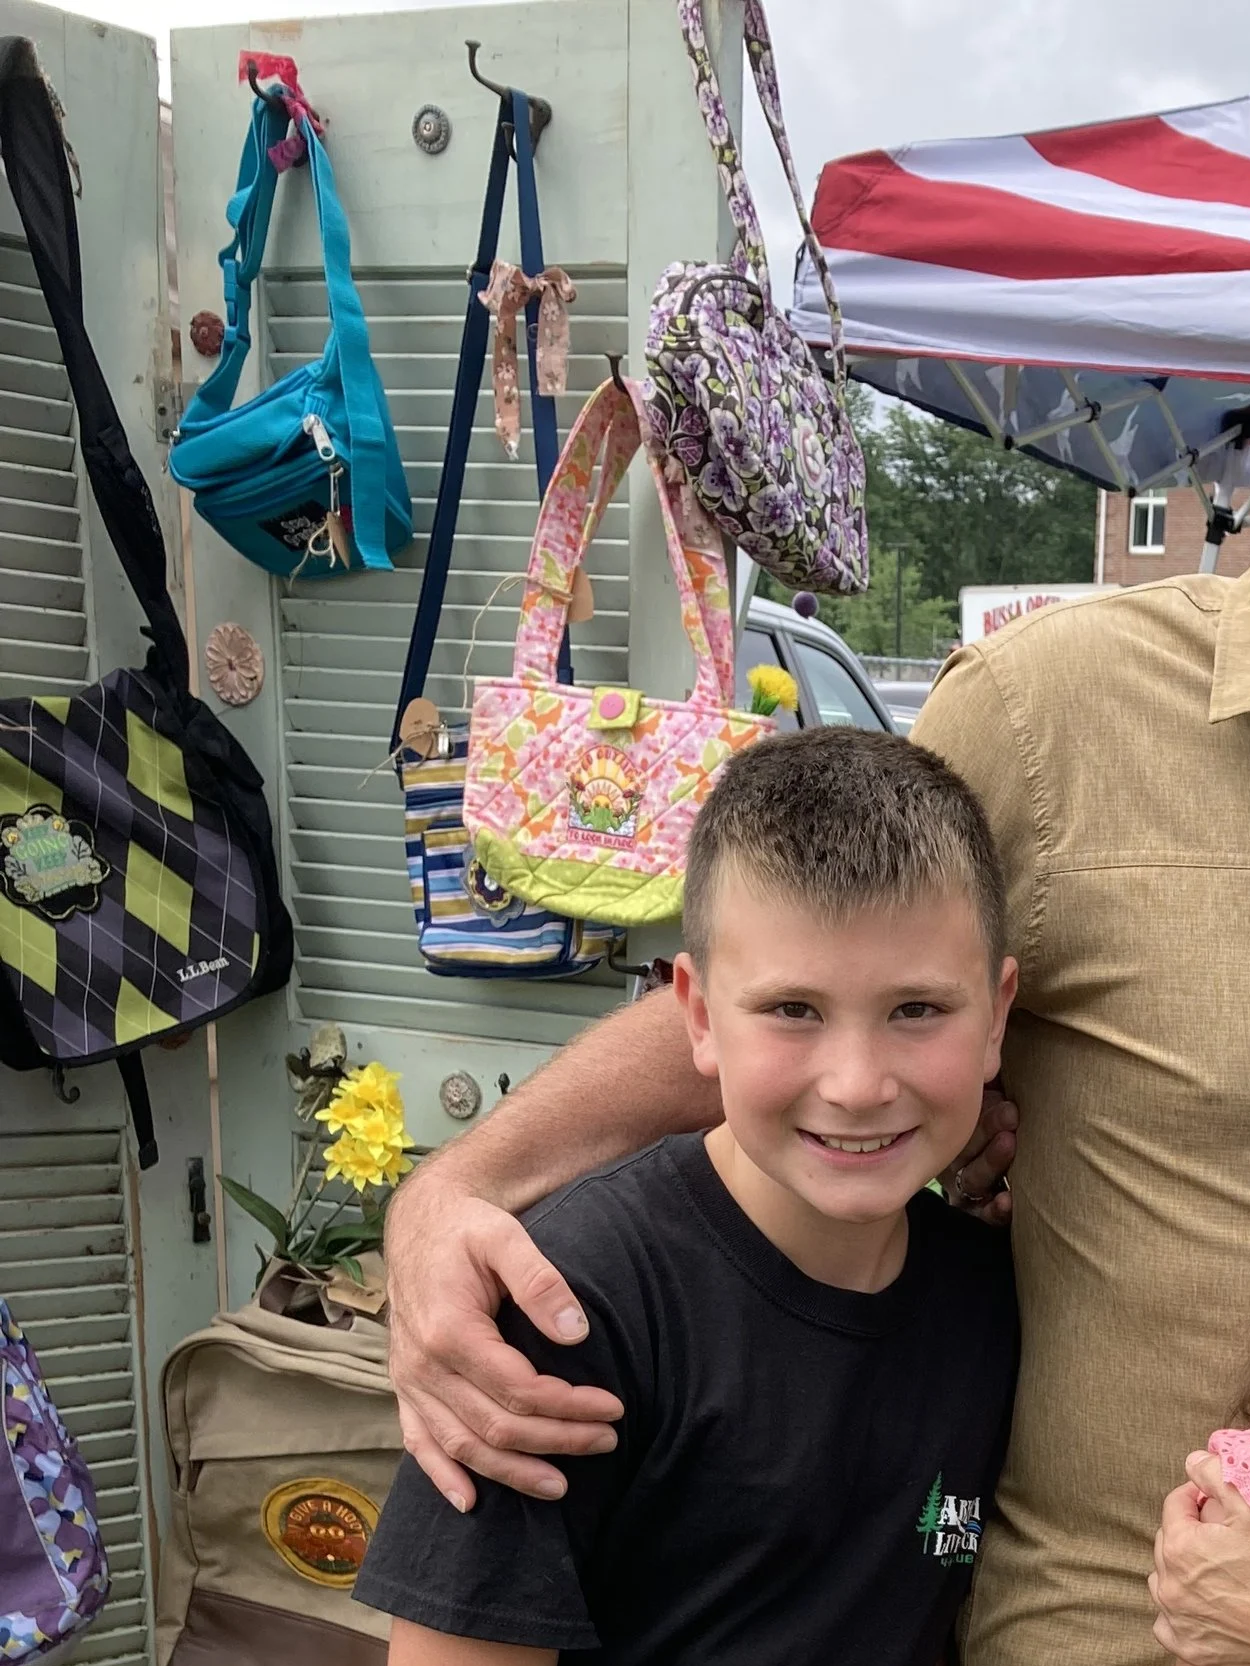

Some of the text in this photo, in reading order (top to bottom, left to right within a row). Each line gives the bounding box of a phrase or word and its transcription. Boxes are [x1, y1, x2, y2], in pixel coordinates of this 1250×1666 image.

[15, 833, 70, 859] GOING
[289, 1500, 319, 1521] GIVE
[322, 1500, 332, 1513] A
